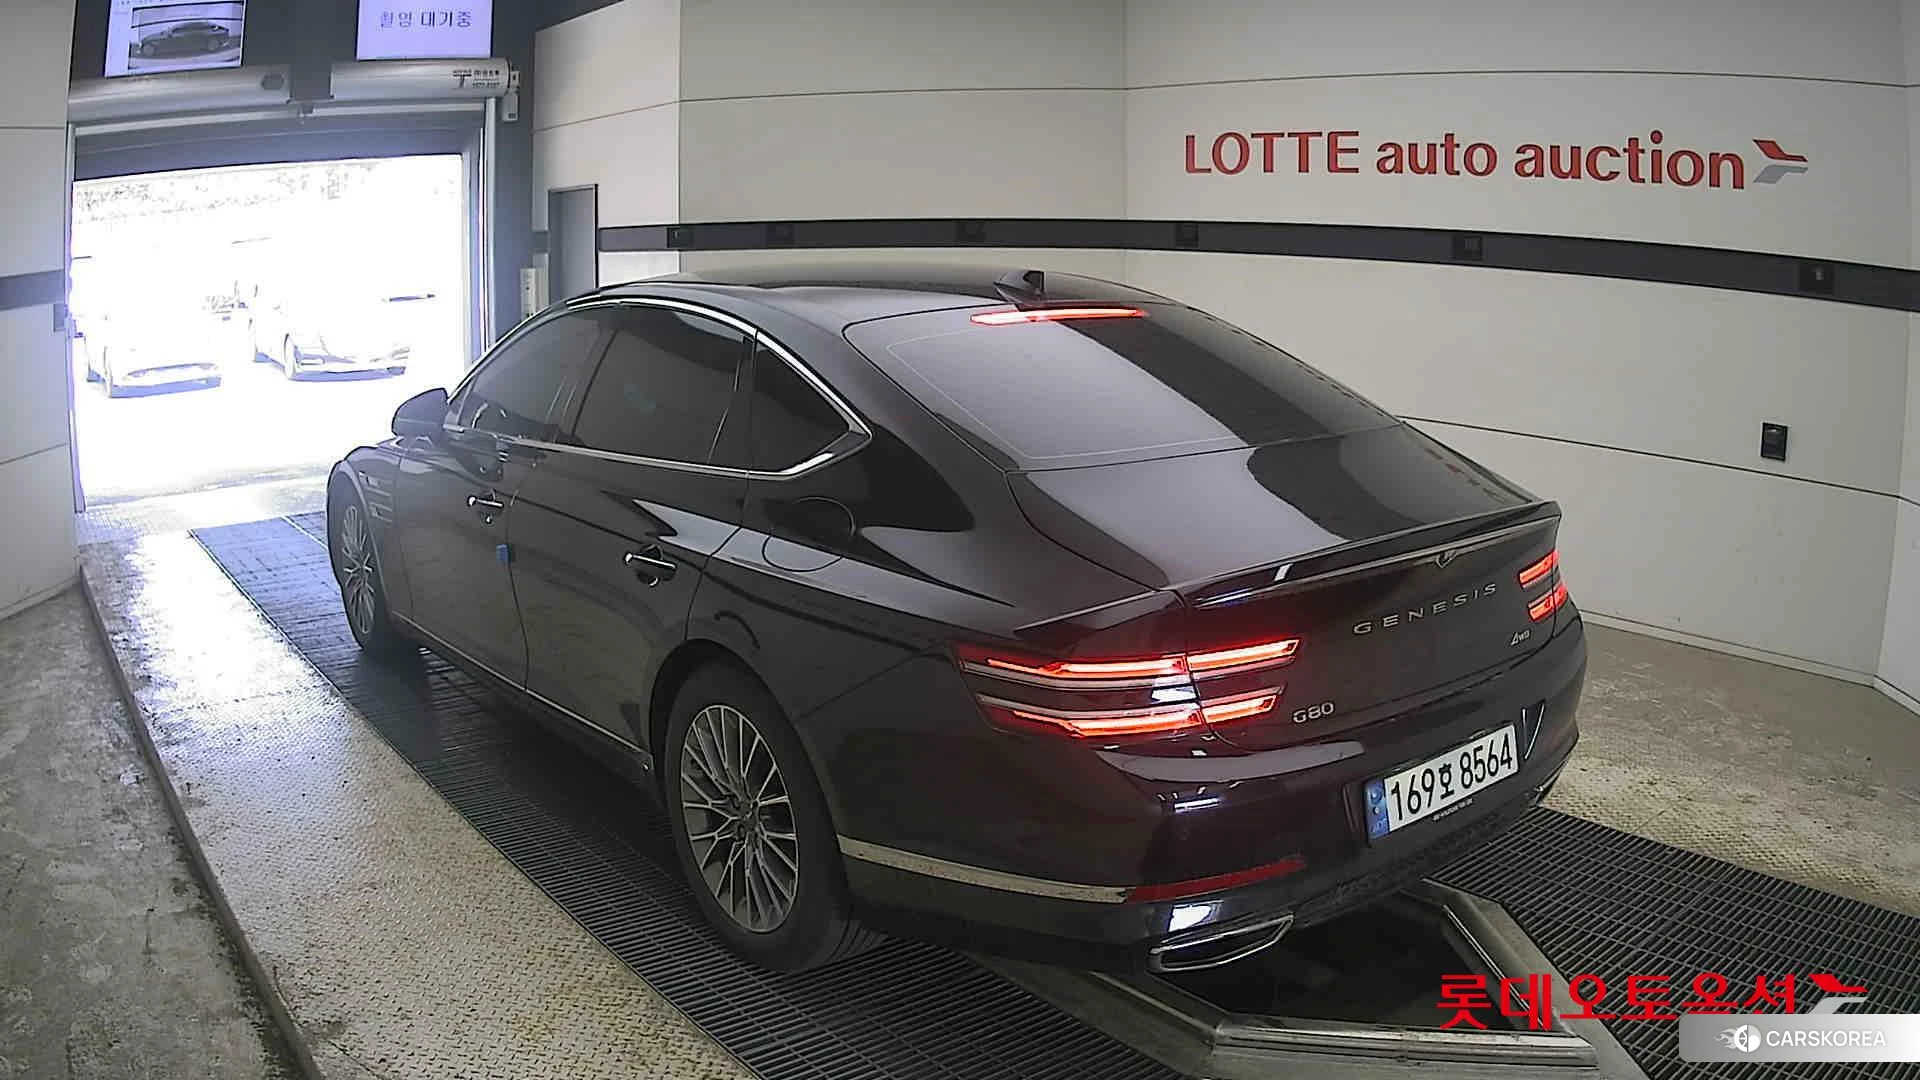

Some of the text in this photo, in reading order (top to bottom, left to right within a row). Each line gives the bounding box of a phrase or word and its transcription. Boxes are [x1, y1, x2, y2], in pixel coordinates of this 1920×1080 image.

[420, 10, 472, 28] 대기중
[1184, 130, 1745, 190] LOTTE auto auction
[1353, 582, 1497, 636] GENESIS
[1292, 701, 1335, 724] G80
[1459, 733, 1513, 790] 8564
